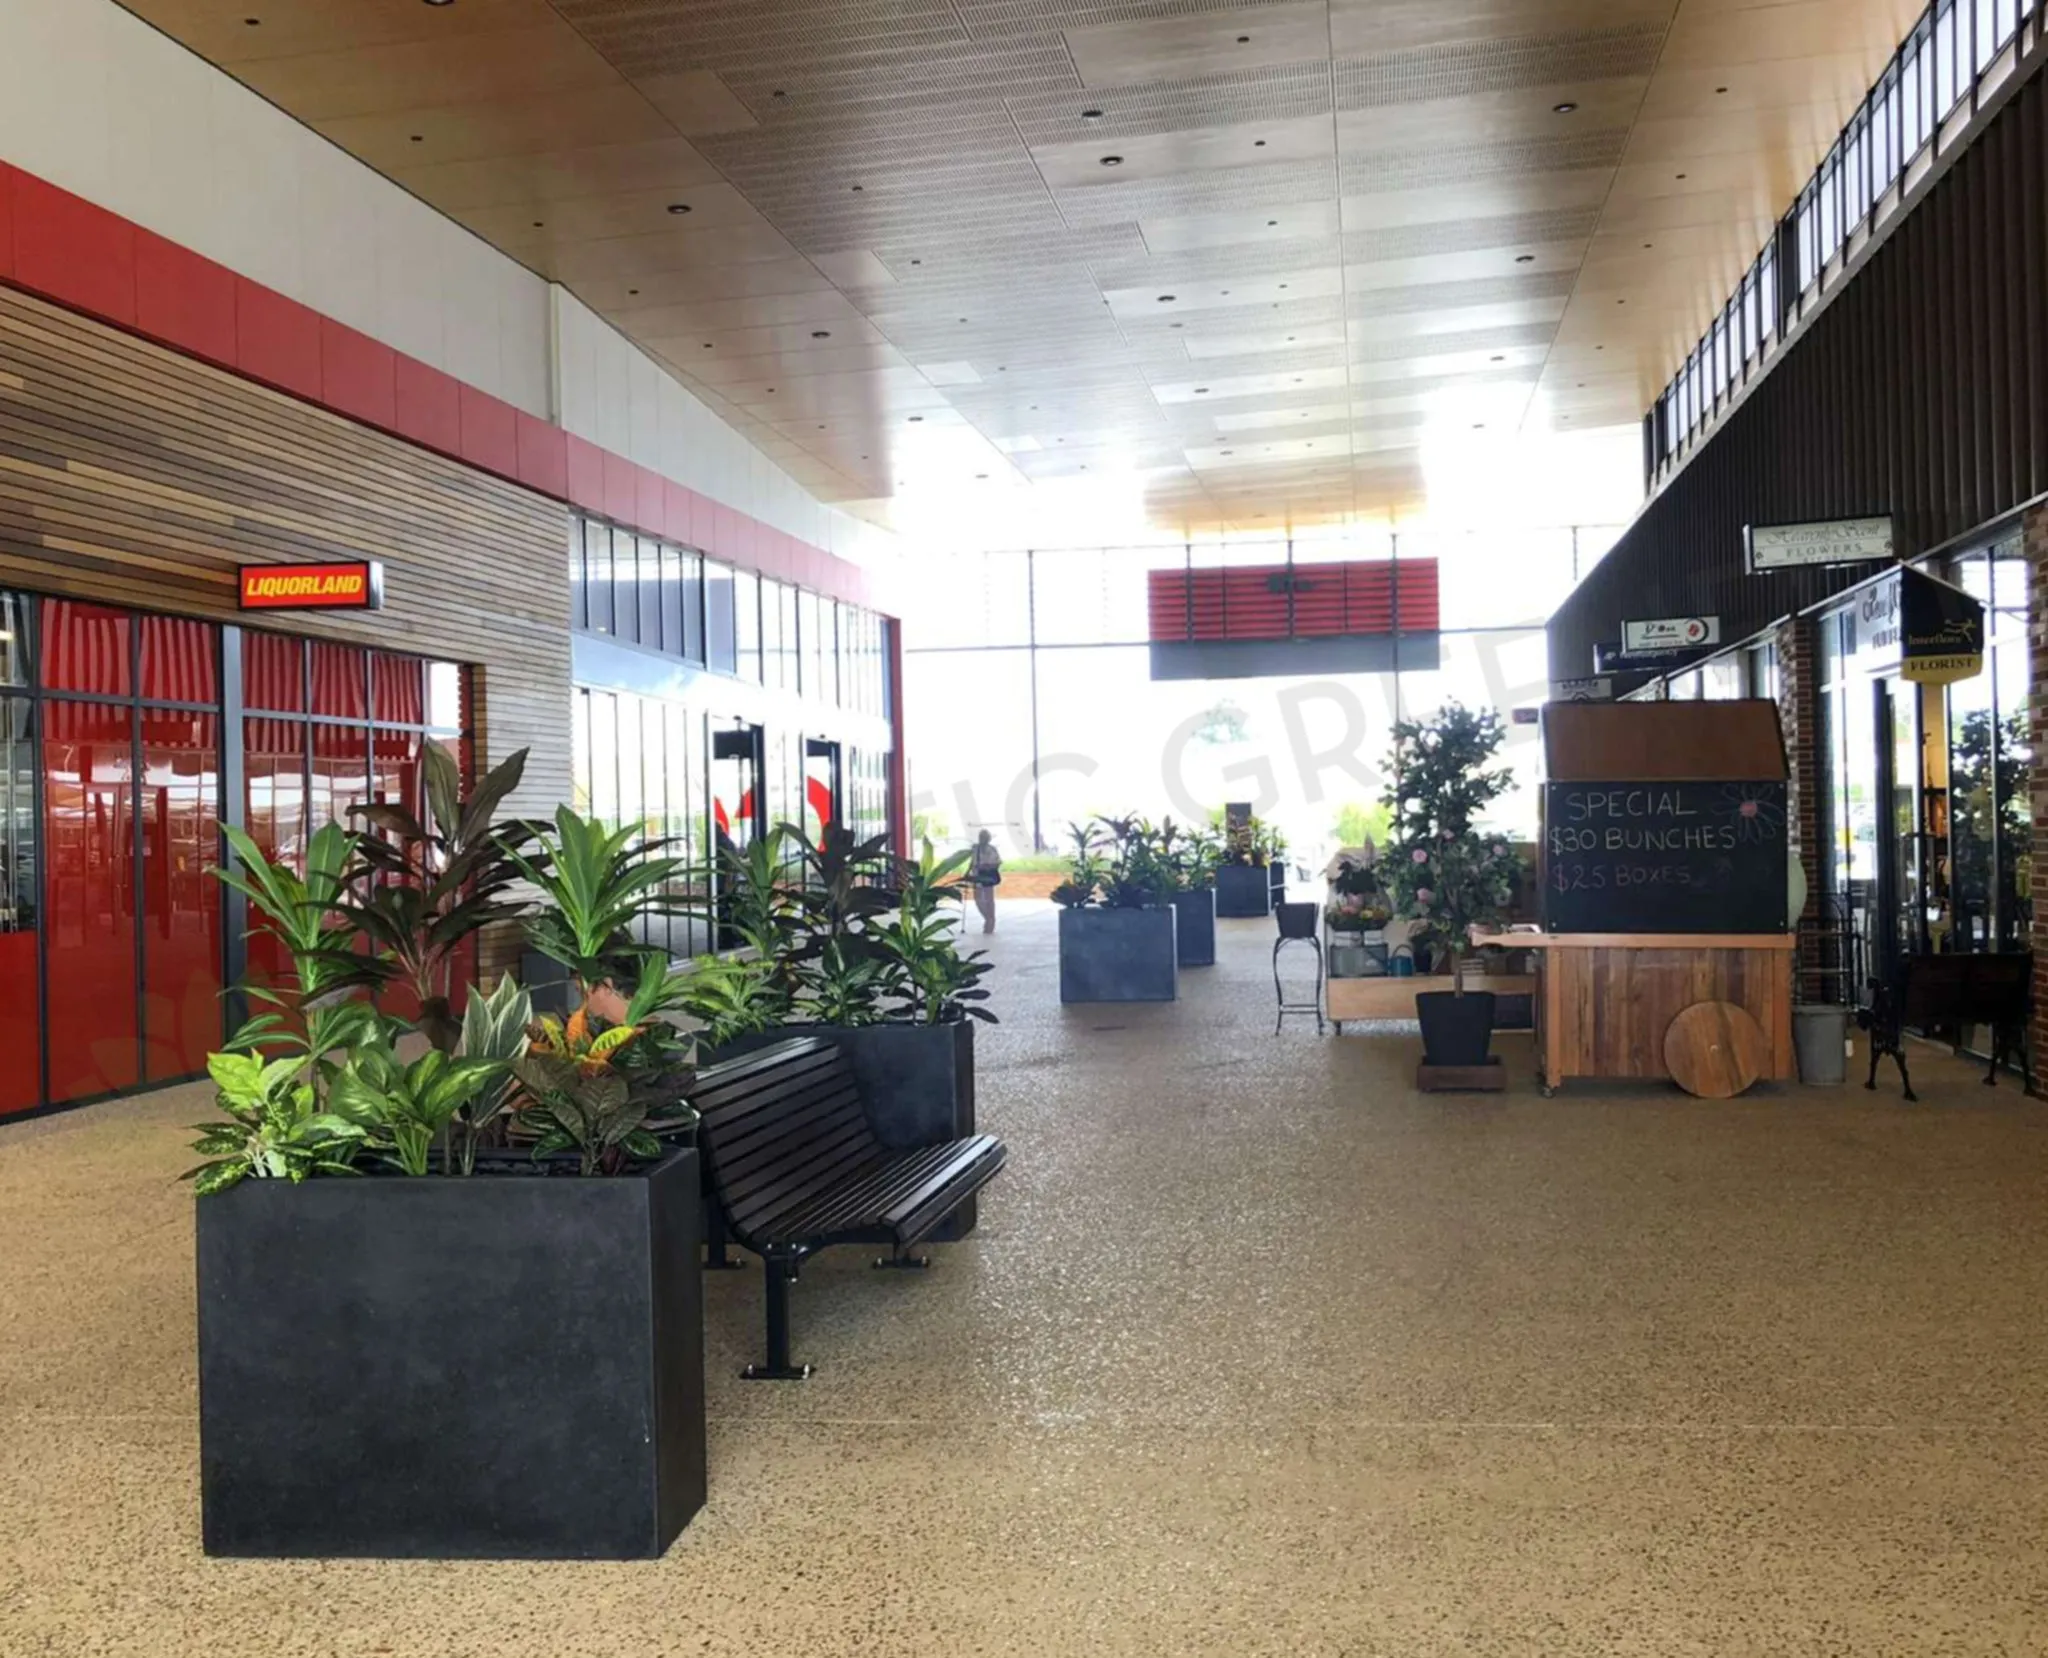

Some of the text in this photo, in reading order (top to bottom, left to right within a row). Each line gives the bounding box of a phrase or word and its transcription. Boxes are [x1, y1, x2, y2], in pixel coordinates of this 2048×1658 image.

[1786, 542, 1863, 558] FLOWERS
[246, 575, 361, 598] LIQUORLAND
[1910, 657, 1974, 672] FLORIST
[1565, 788, 1698, 821] SPECIAL
[1549, 825, 1737, 857] $30 BUNCHES
[1551, 862, 1691, 897] $25 BOXES
